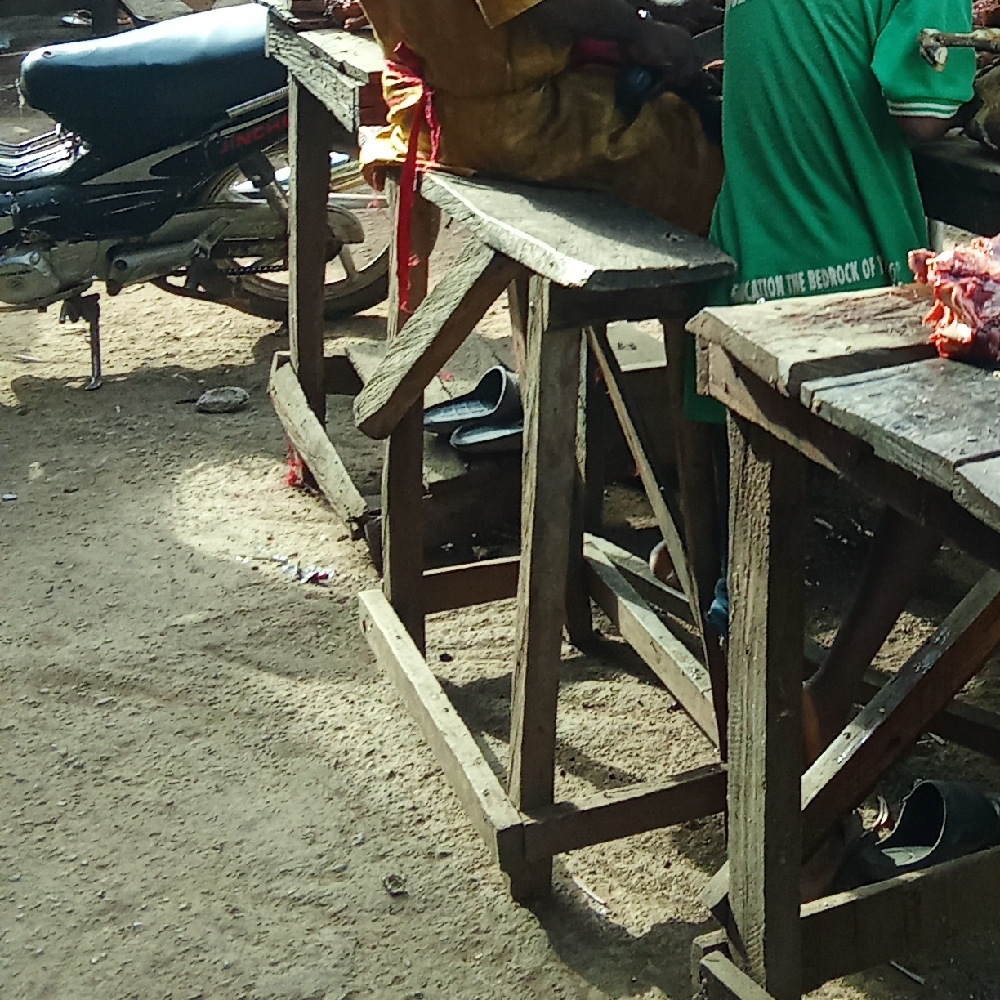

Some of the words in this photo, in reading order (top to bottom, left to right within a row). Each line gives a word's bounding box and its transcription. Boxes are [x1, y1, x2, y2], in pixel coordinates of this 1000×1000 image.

[784, 270, 806, 294] THE
[807, 260, 860, 290] BEDROCK
[861, 256, 876, 278] OF
